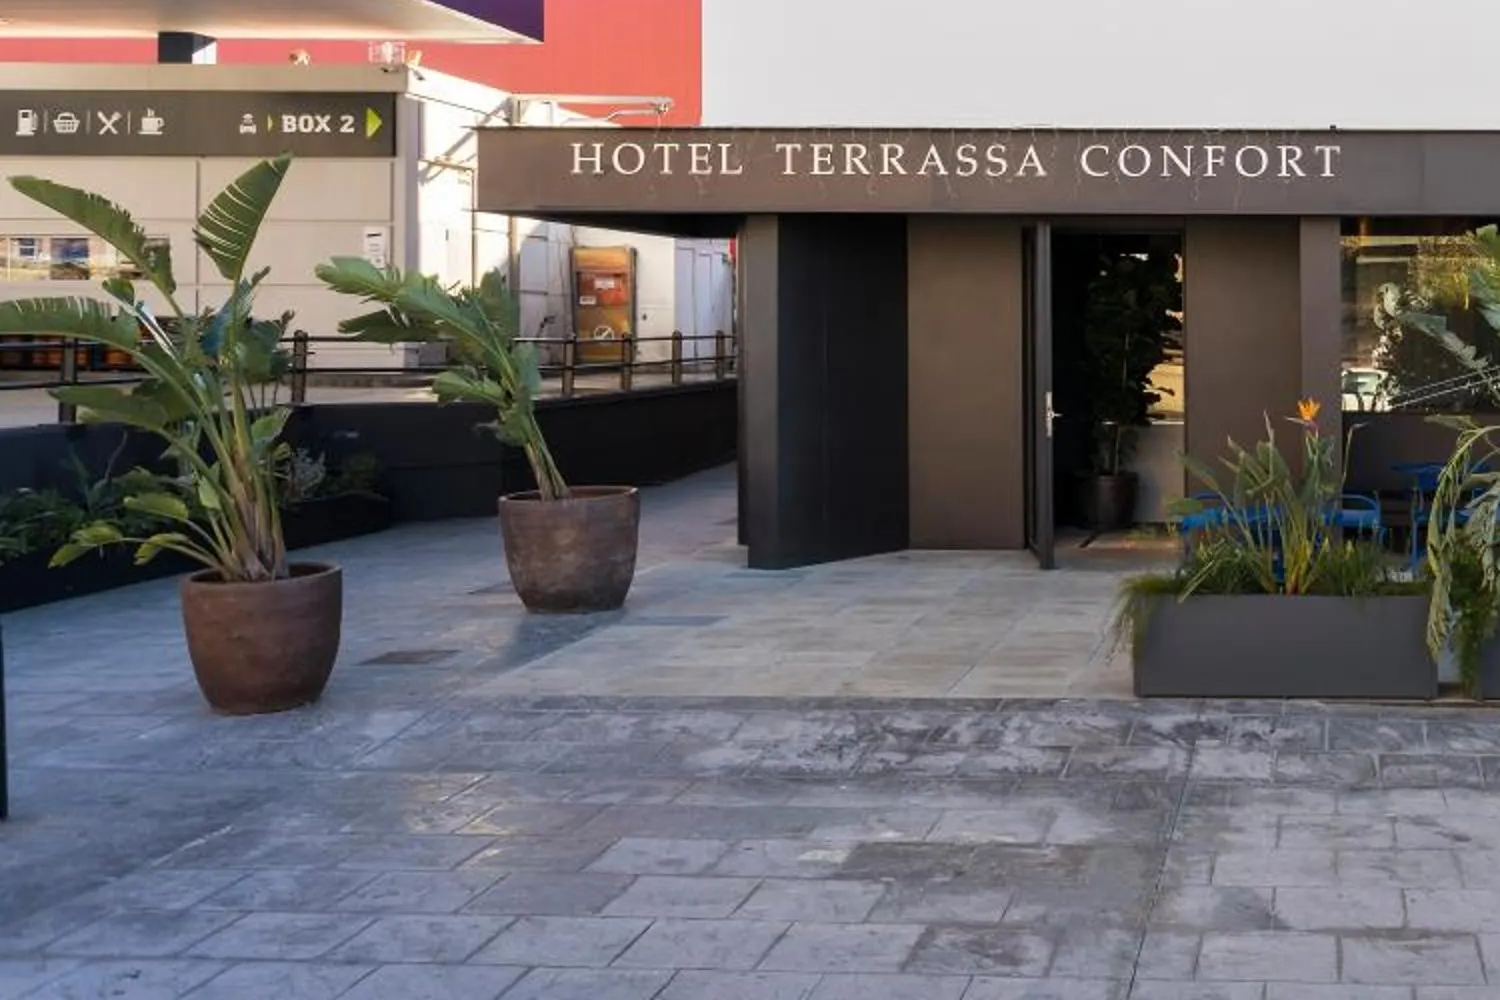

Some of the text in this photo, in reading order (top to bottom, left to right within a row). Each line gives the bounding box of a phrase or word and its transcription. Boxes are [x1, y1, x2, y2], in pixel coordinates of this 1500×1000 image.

[281, 114, 355, 133] BOX 2
[570, 143, 1341, 177] HOTEL TERRASSA CONFORT
